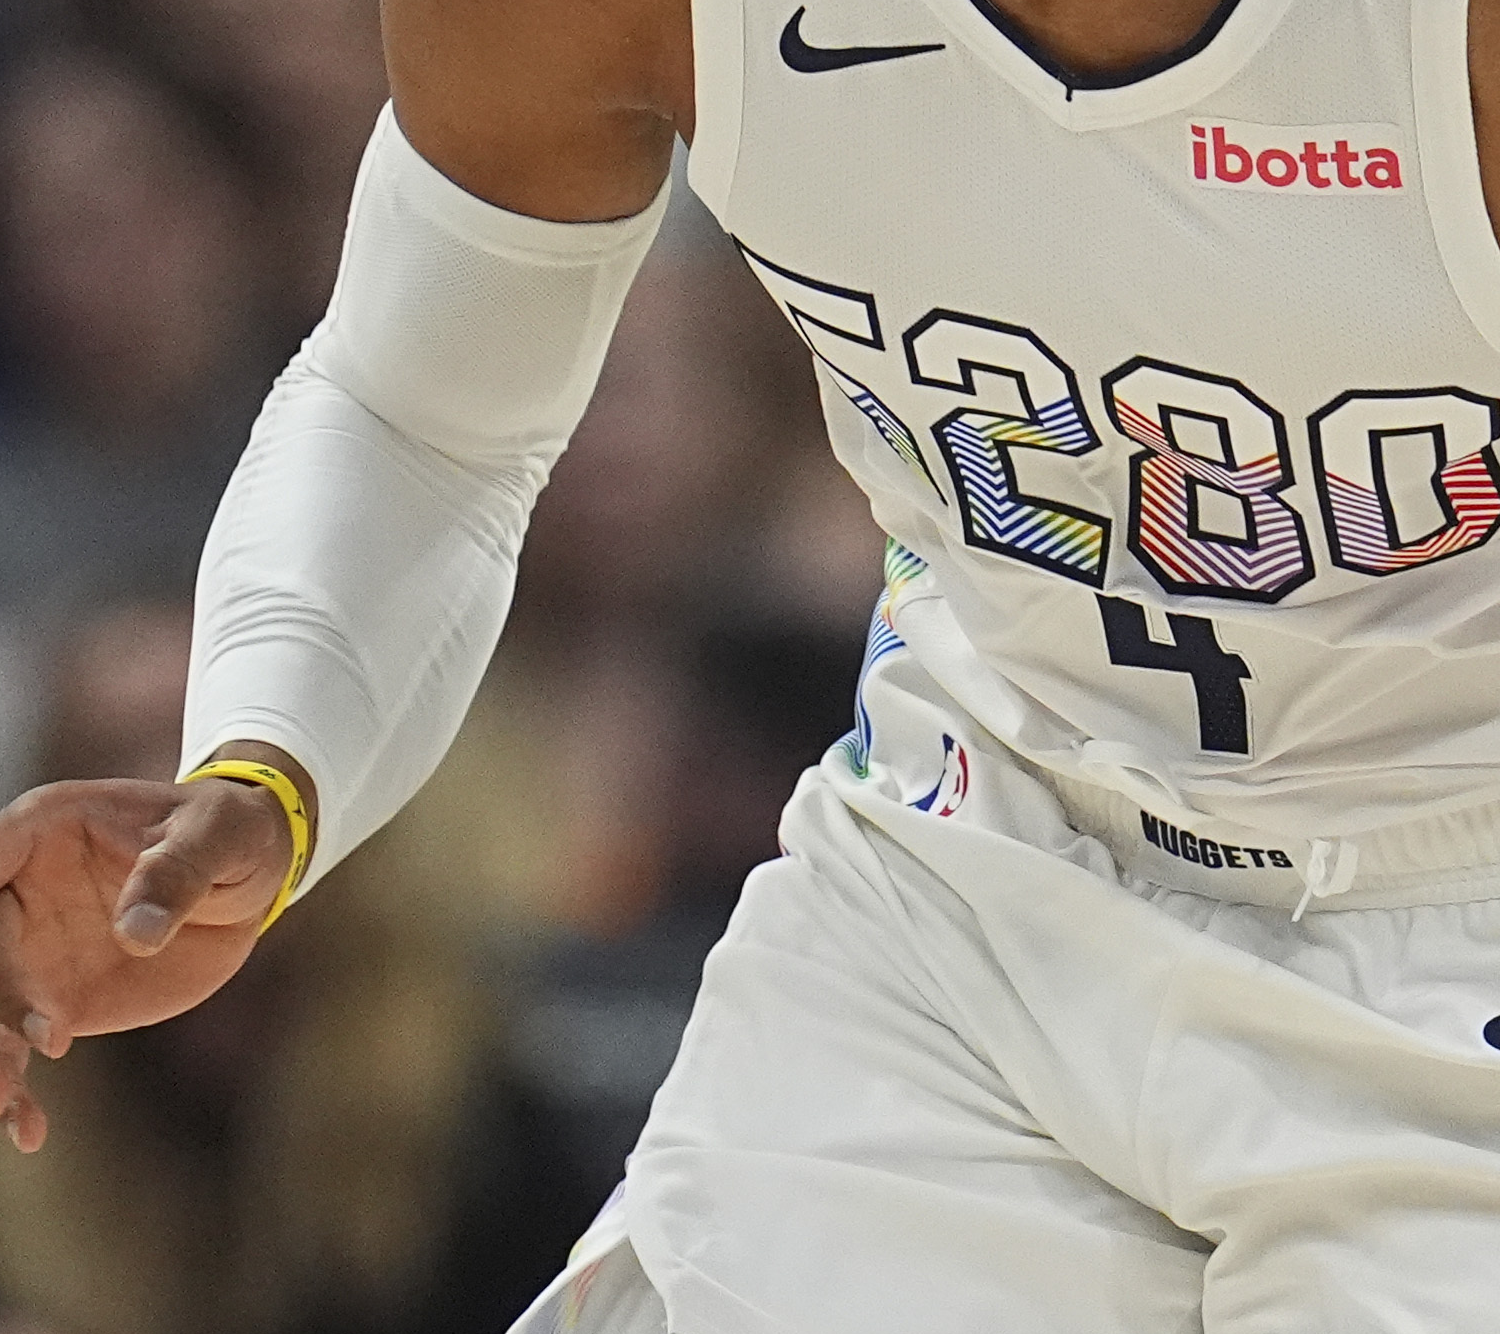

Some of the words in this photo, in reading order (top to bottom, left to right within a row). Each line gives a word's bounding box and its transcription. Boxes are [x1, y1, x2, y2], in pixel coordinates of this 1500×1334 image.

[1191, 124, 1403, 188] ibotta
[1094, 591, 1254, 757] 4
[1140, 809, 1294, 869] NUGGETS
